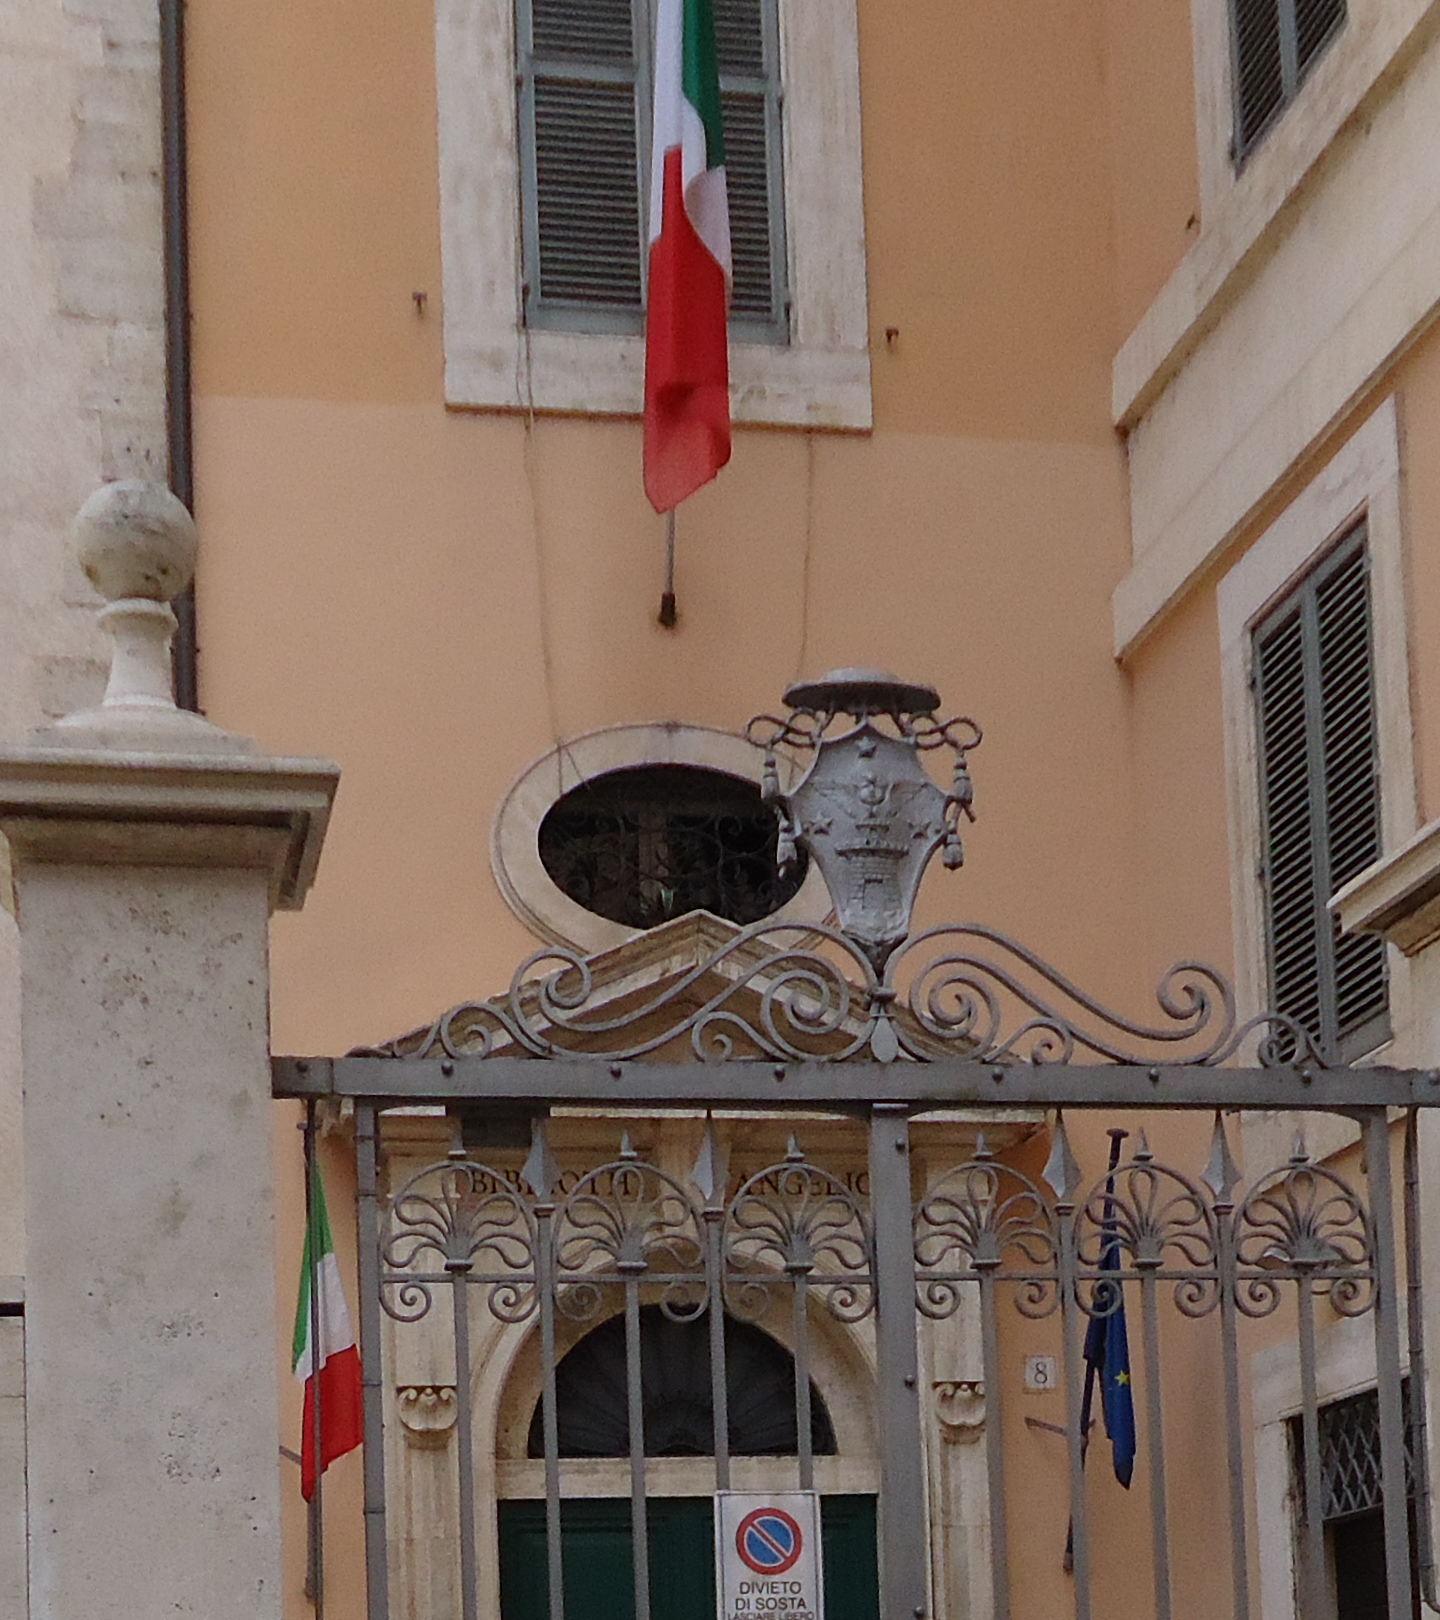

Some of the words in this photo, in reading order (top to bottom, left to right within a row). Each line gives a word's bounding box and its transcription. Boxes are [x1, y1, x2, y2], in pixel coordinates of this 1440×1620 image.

[1034, 1362, 1048, 1384] 8
[739, 1581, 802, 1595] DIVIETO
[735, 1598, 751, 1611] DI
[755, 1597, 807, 1611] SOSTA
